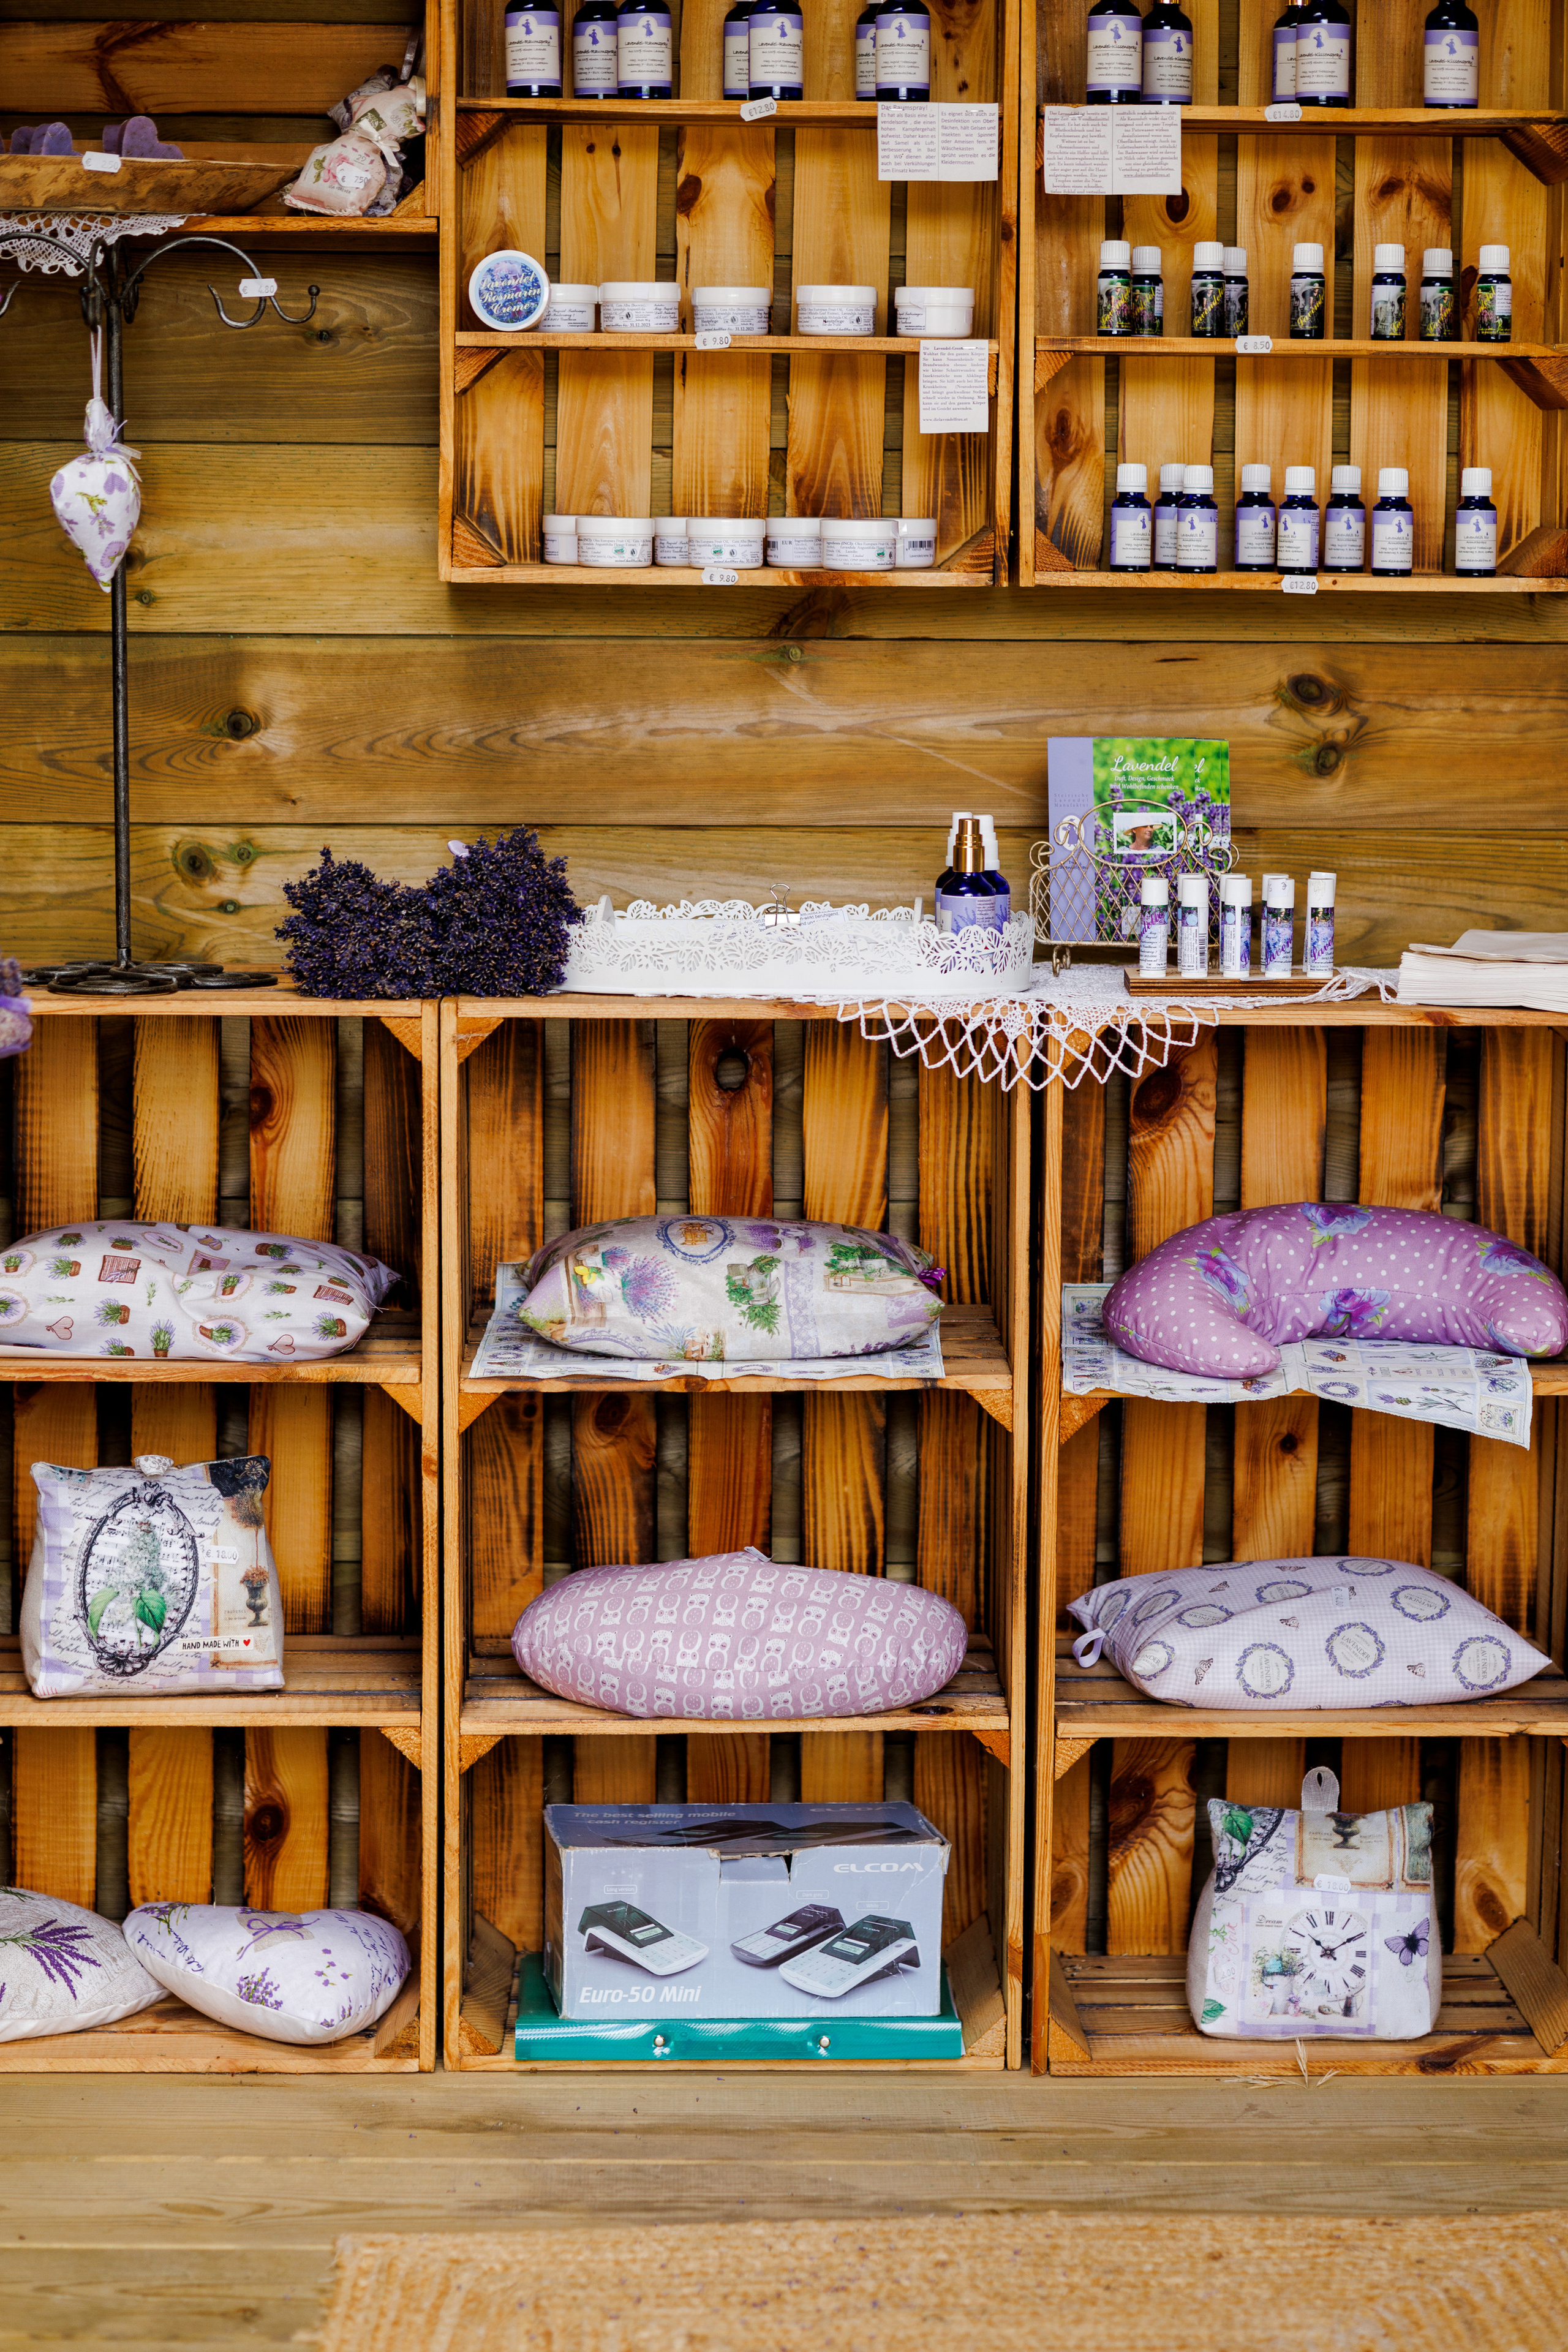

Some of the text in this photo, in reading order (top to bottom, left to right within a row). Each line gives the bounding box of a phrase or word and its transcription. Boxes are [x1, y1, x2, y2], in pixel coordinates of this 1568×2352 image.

[85, 158, 118, 170] € 2.50
[480, 271, 536, 290] Lavendel
[480, 287, 541, 302] Rosmarin
[491, 302, 531, 315] Creme
[712, 336, 729, 345] 9.80
[1254, 341, 1270, 350] 8.50
[709, 573, 736, 582] € 9.80
[1110, 755, 1179, 772] Lavendel
[216, 1550, 238, 1560] 18.00
[183, 1641, 200, 1649] HAND
[203, 1640, 221, 1648] MADE
[1341, 1635, 1371, 1660] LAVENDER
[833, 1863, 924, 1873] ELCOM
[1327, 1882, 1348, 1891] 18.00
[579, 1986, 702, 2003] Euro-50 Mini
